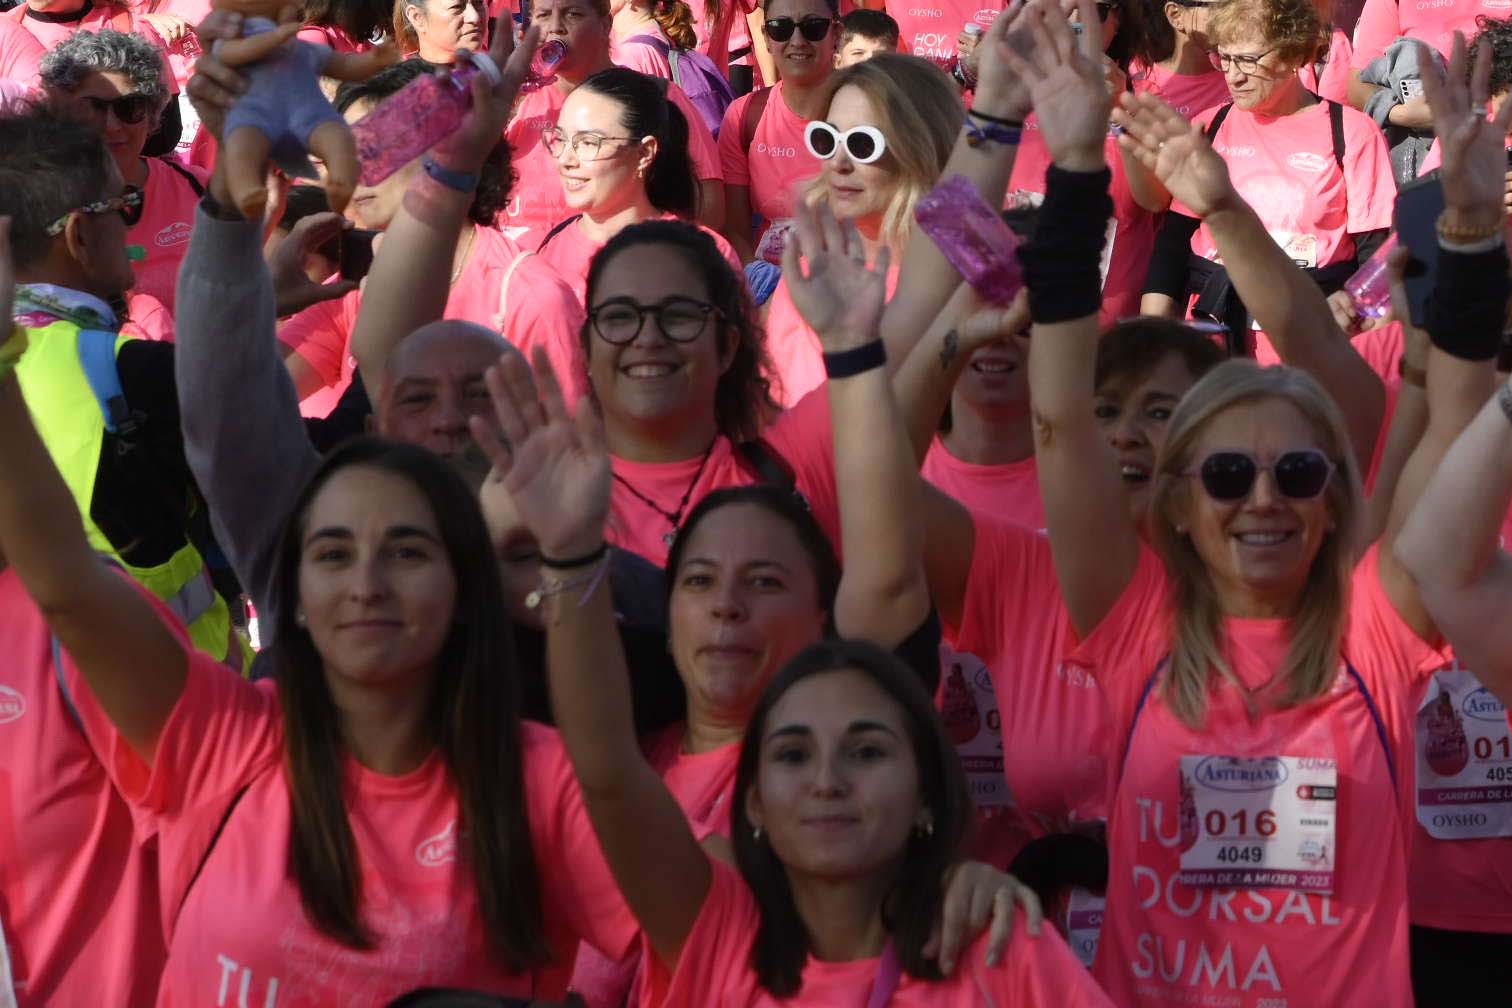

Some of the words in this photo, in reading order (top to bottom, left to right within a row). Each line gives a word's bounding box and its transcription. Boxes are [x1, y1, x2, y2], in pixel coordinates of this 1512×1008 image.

[908, 8, 943, 18] OYSHO
[914, 32, 946, 47] HOY
[757, 143, 796, 158] OYSHO
[1203, 764, 1282, 782] ASTURIANA
[1438, 789, 1486, 802] CARRERA
[1487, 789, 1501, 801] DE
[1136, 797, 1182, 848] TU
[1205, 809, 1278, 837] 016
[1432, 812, 1487, 828] OYSHO
[1217, 845, 1264, 864] 4049
[1255, 874, 1298, 886] MUJER
[1132, 864, 1341, 926] DORSAL
[1131, 932, 1283, 992] SUMA
